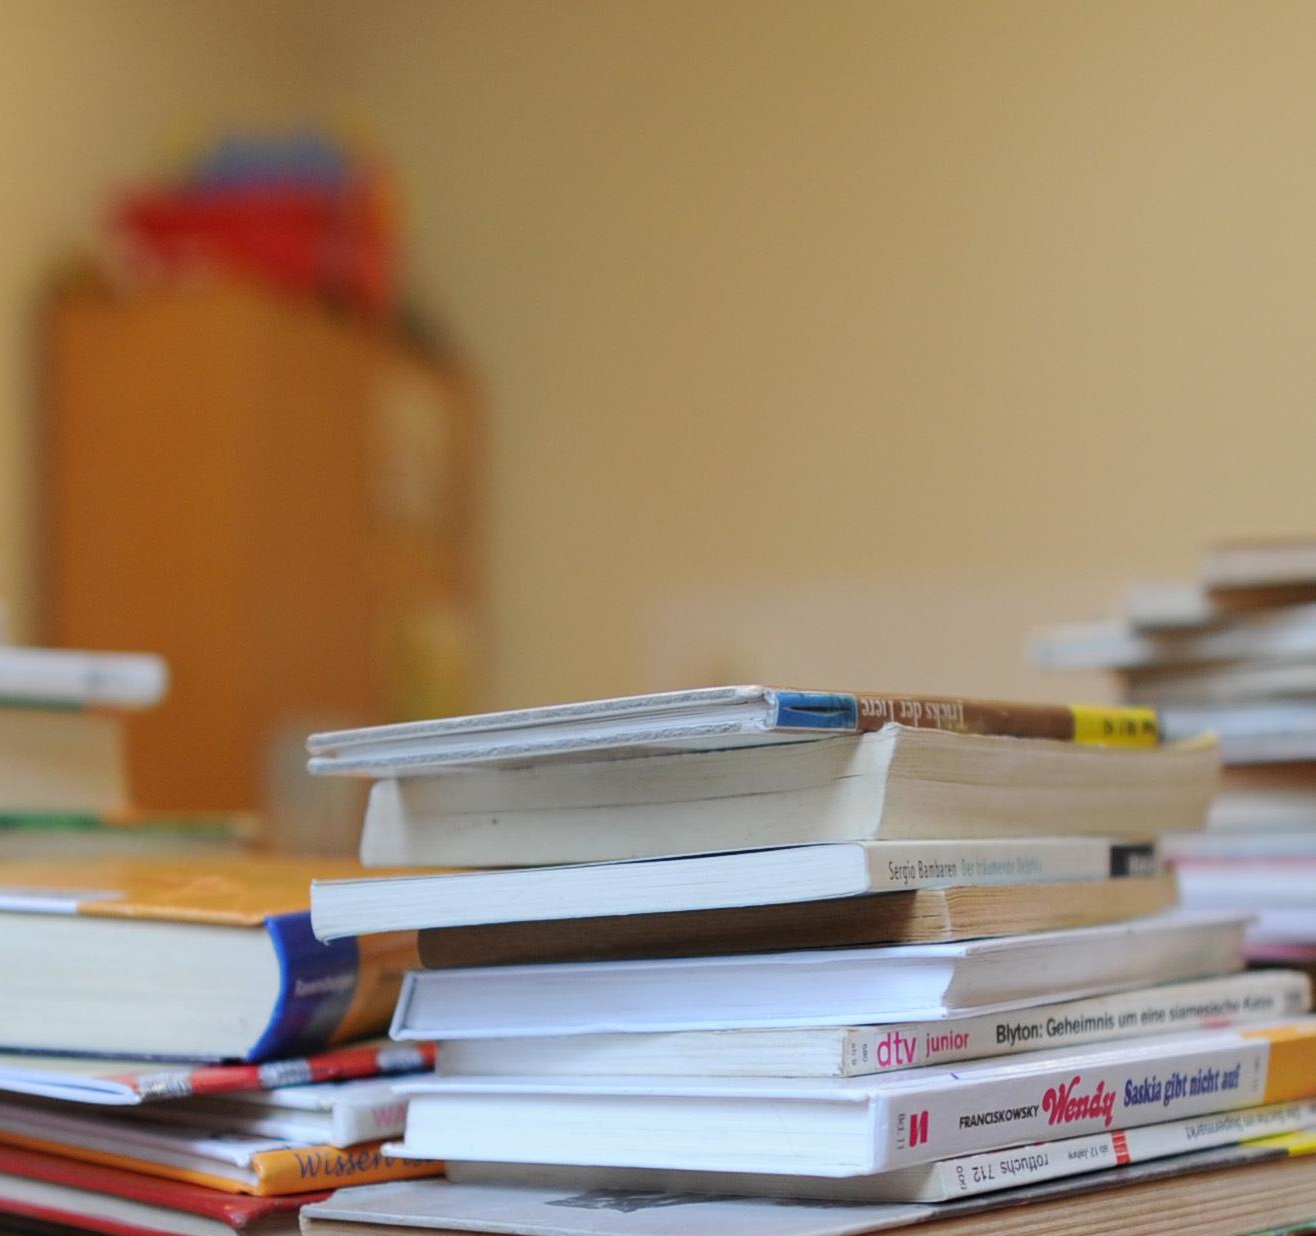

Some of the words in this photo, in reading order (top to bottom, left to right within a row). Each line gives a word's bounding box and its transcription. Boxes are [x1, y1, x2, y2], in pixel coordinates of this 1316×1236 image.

[900, 701, 922, 728] der
[928, 700, 965, 728] Tricks
[888, 861, 916, 884] Sergio
[918, 860, 958, 880] Bambaren
[996, 1020, 1044, 1047] Blyton:
[1046, 1015, 1115, 1038] Geheimnis
[1117, 1015, 1139, 1029] um
[1140, 1010, 1166, 1027] eine
[1169, 998, 1240, 1023] siamesische
[877, 1032, 917, 1068] dtv
[925, 1031, 970, 1059] junior
[959, 1105, 1039, 1130] FRANCISKOWSKY
[1042, 1074, 1116, 1125] Wendy
[1123, 1079, 1162, 1107] Saskia
[1163, 1073, 1188, 1103] gibt
[1190, 1068, 1219, 1096] nicht
[1220, 1063, 1242, 1090] auf
[972, 1163, 995, 1182] 712
[999, 1153, 1049, 1176] rotfuchs
